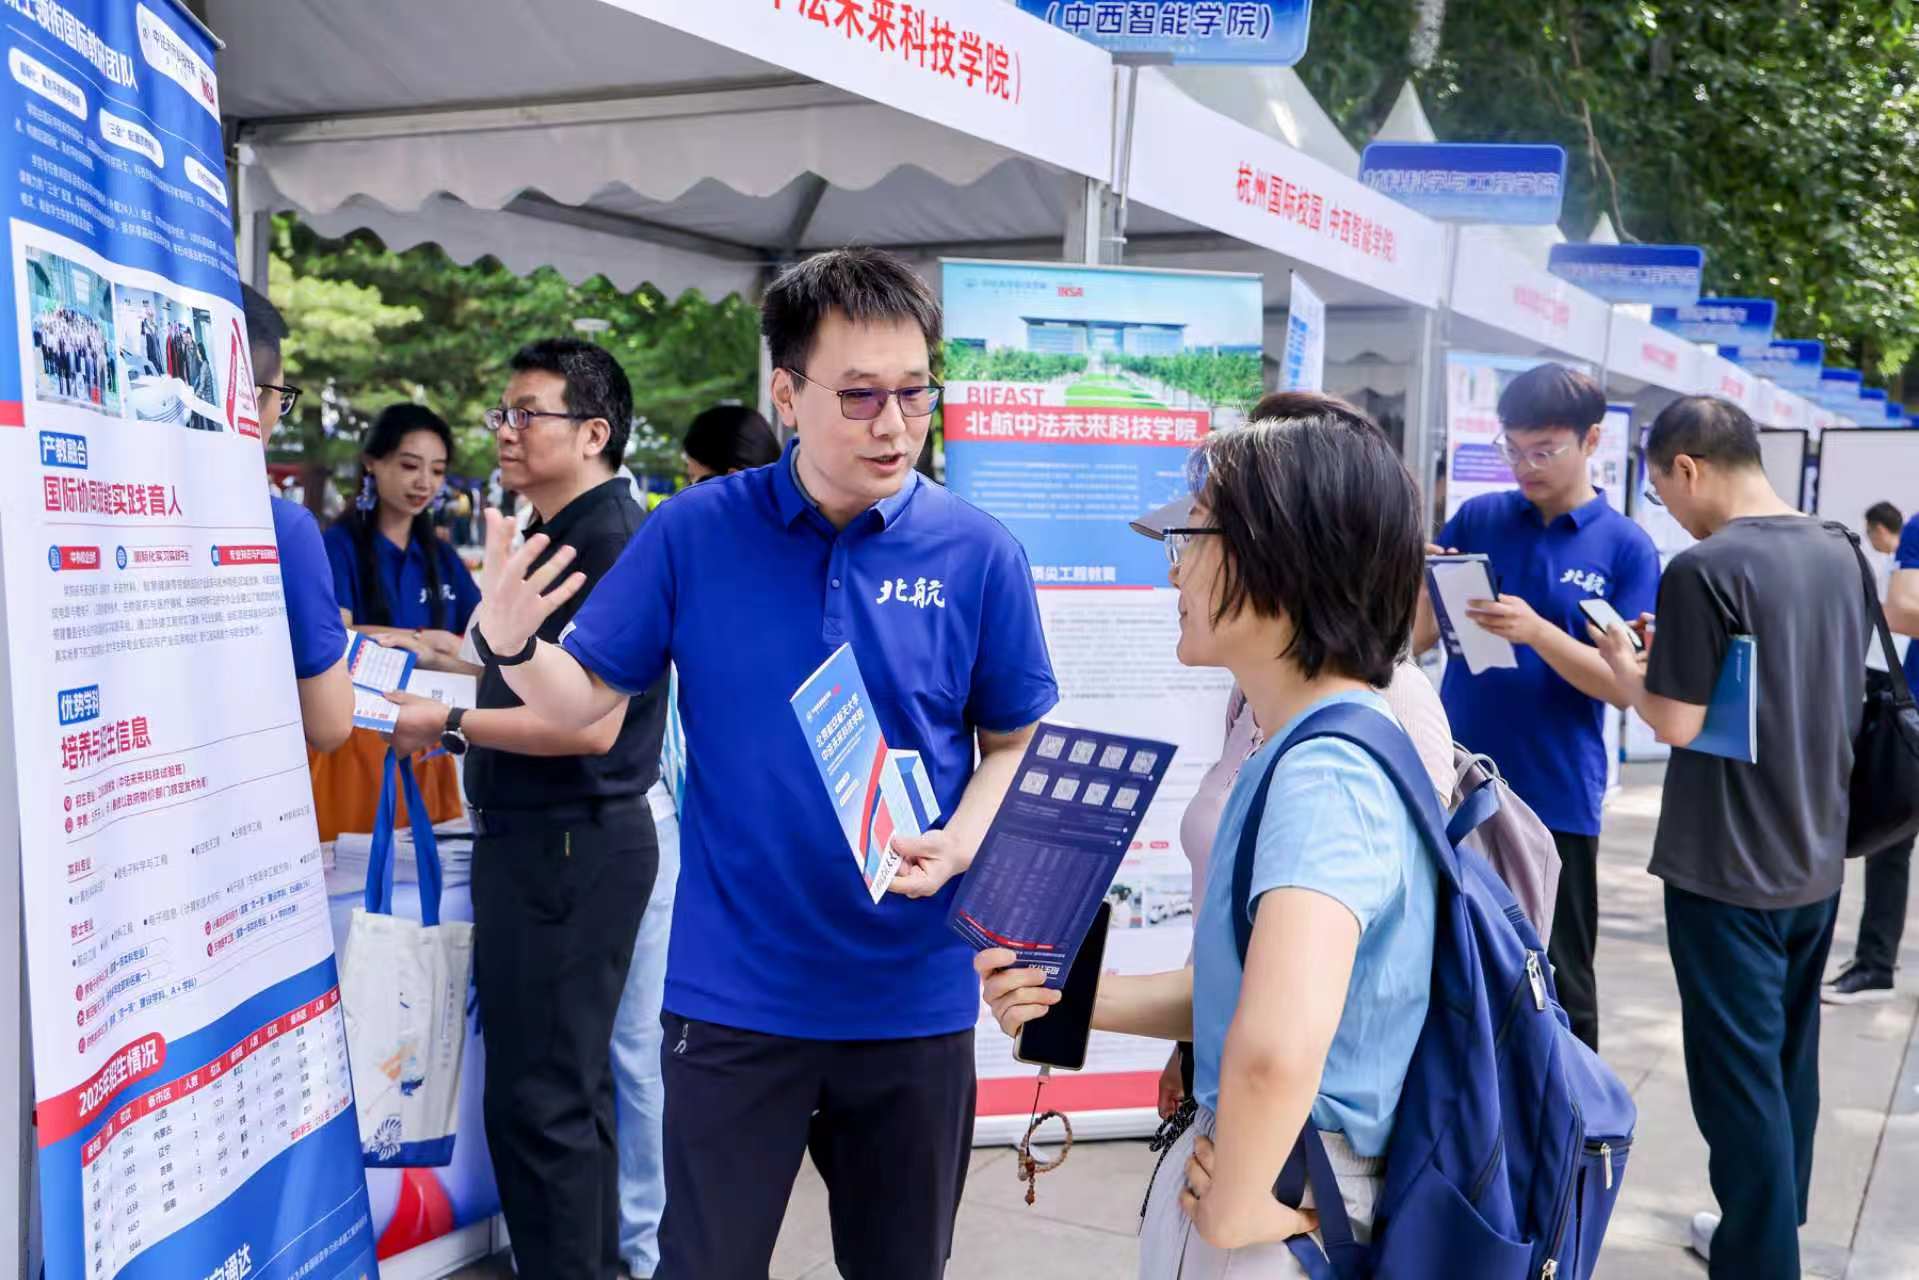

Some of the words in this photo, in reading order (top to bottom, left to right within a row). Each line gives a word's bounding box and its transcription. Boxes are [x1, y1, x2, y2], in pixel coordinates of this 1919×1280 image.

[774, 0, 1021, 104] 未来科技学院）
[967, 386, 1045, 406] BIFAST
[965, 411, 1199, 442] 北航中法未来科技学院
[41, 435, 87, 466] 产教融合
[876, 576, 945, 608] 北航
